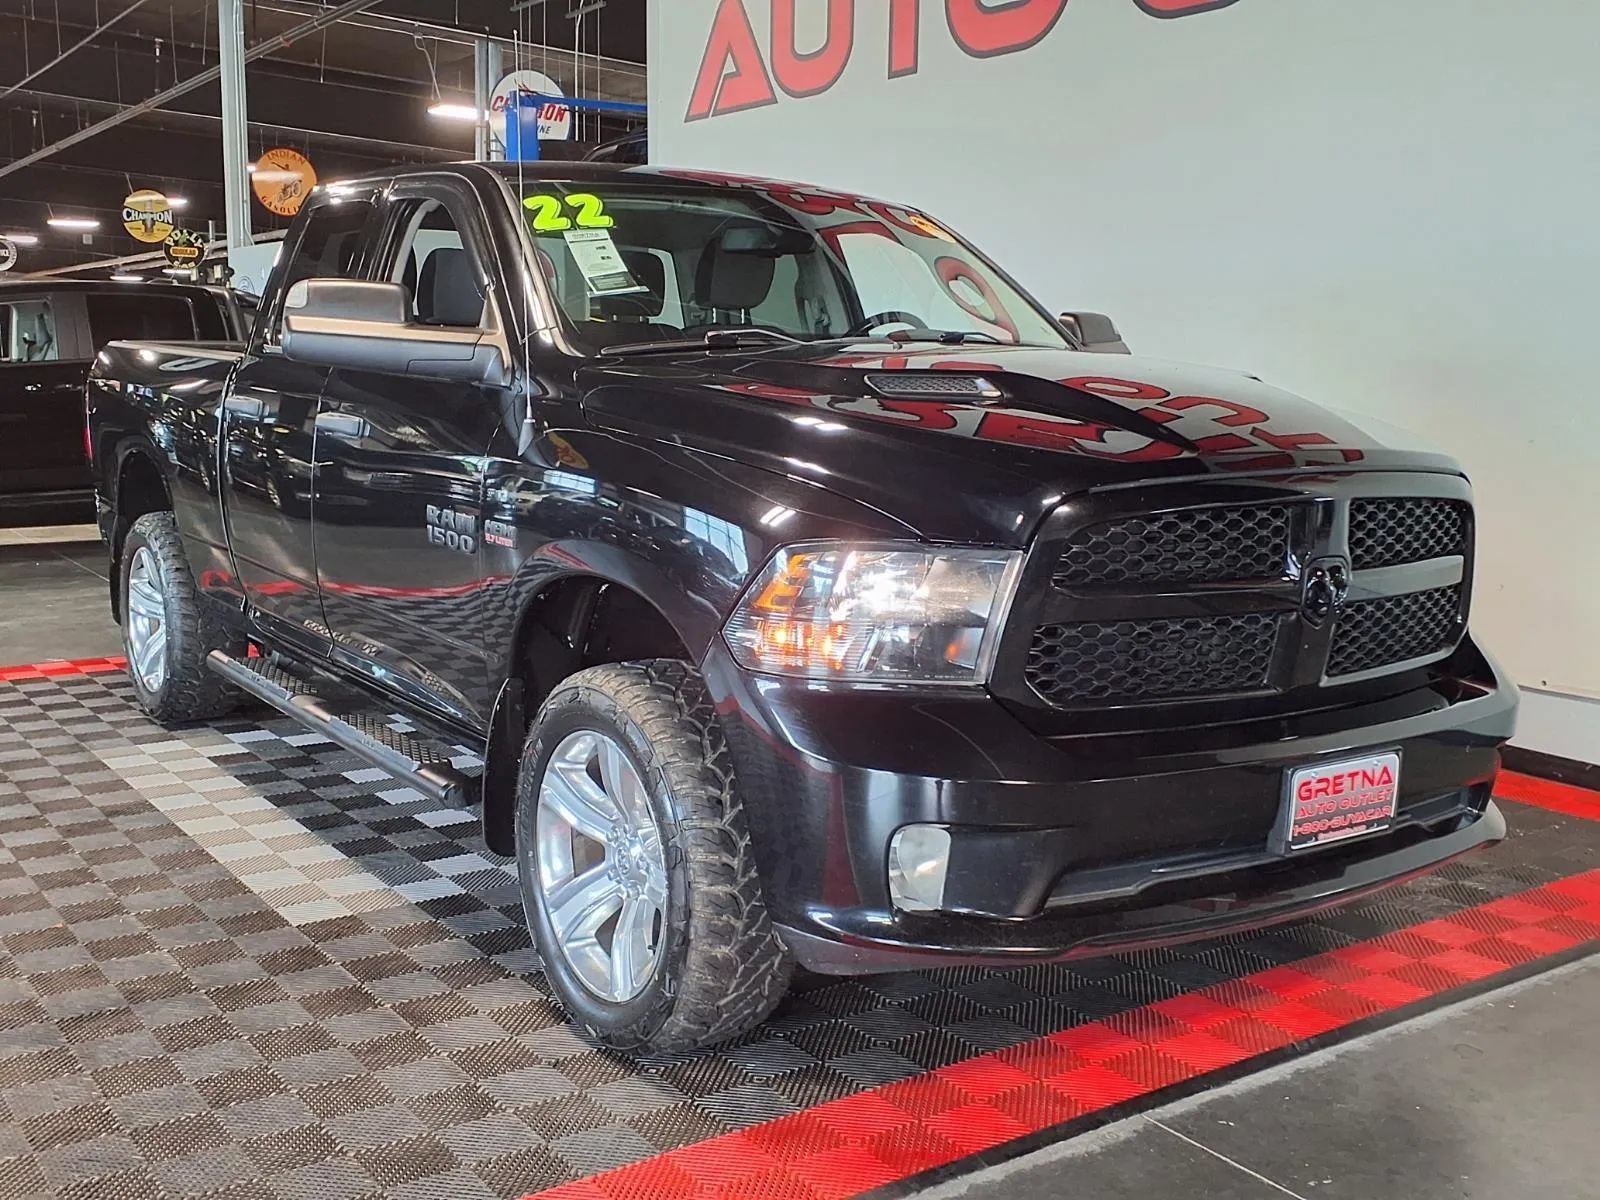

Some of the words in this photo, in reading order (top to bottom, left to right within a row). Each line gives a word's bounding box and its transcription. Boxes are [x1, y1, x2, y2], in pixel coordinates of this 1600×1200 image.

[266, 150, 306, 166] INDIAN
[522, 193, 614, 231] 22
[426, 504, 476, 533] RAM
[426, 525, 476, 554] 1500
[1297, 766, 1393, 801] GRETNA
[1295, 800, 1337, 820] AUTO
[1339, 788, 1393, 809] OUTLET
